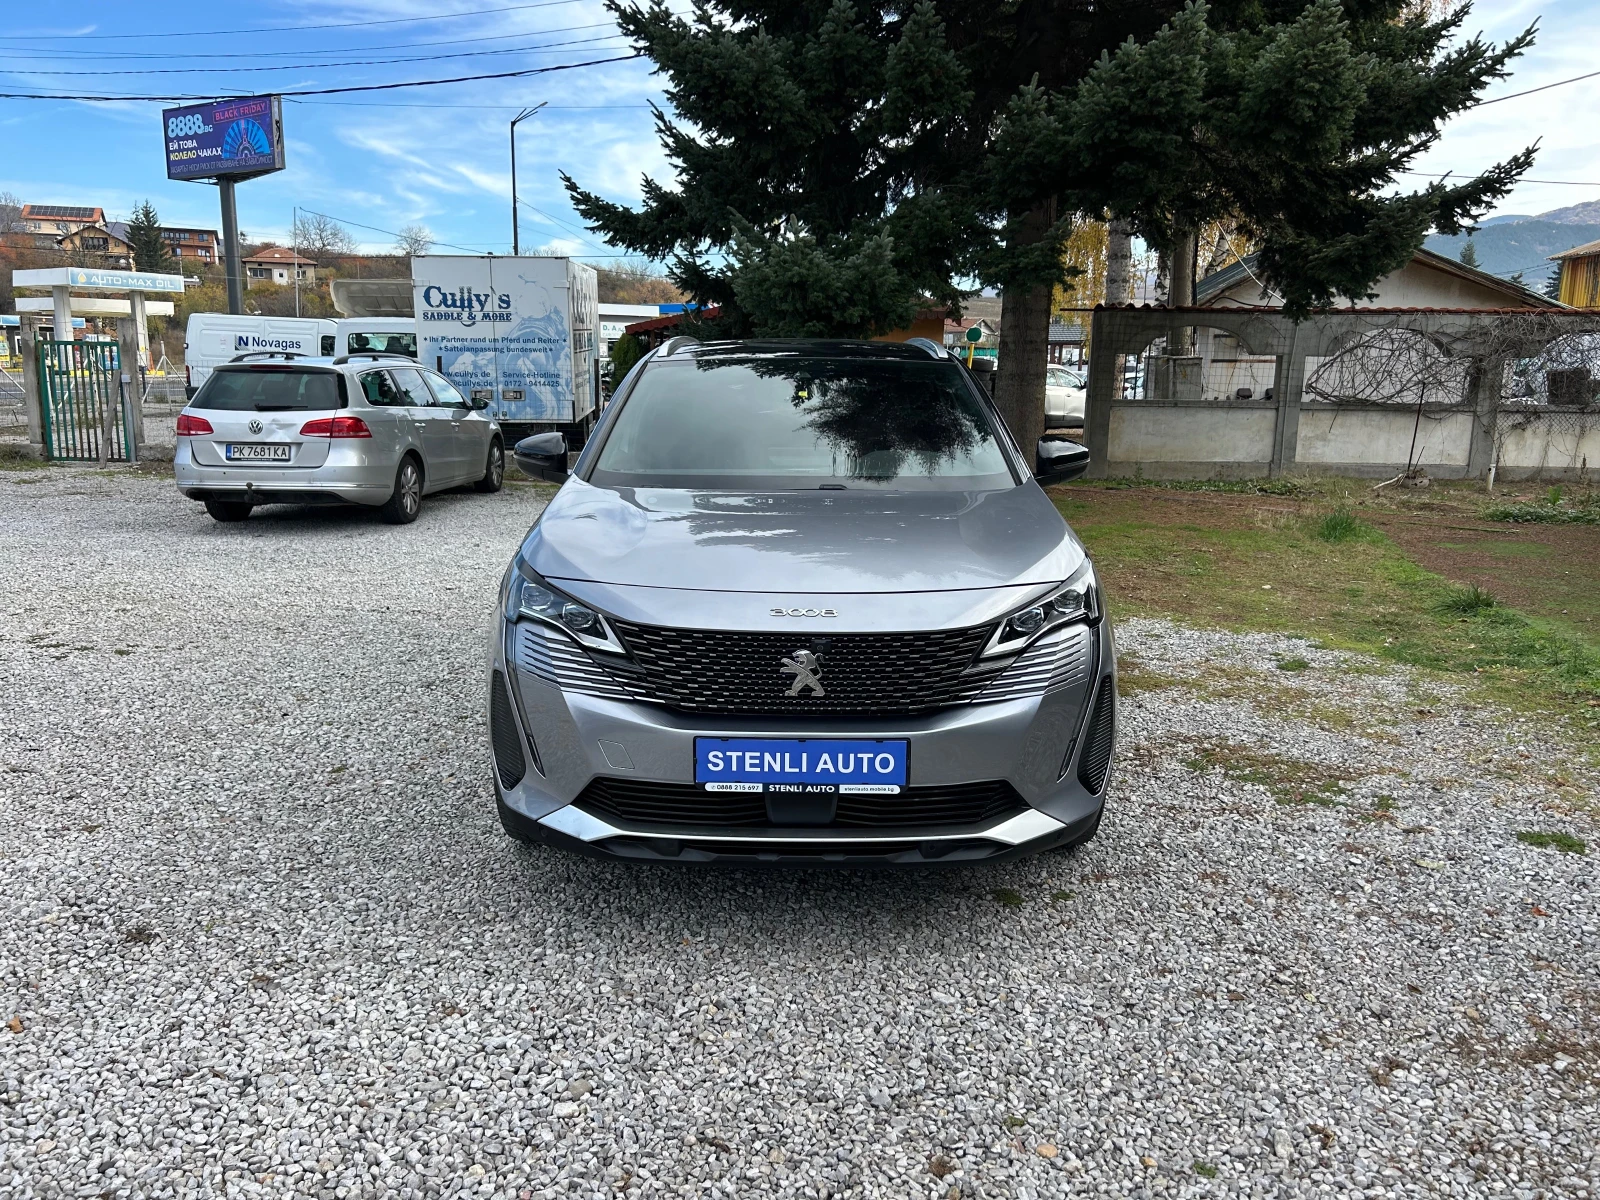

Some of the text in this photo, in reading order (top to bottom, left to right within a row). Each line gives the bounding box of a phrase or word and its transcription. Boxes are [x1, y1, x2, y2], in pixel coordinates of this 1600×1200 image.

[215, 102, 266, 121] BLACK FRIDAY
[169, 139, 198, 151] ЕЙ ТОВА
[170, 146, 222, 161] КОЛЕЛО ЧАКАХ
[156, 279, 175, 288] OIL
[422, 312, 512, 321] SADDLE & MORE
[252, 336, 302, 351] Novagas
[440, 336, 469, 344] Partner
[501, 336, 521, 344] Pferd
[522, 336, 538, 344] und
[444, 345, 505, 354] Sattelanpassung
[502, 371, 560, 379] Service-Hotline
[769, 608, 839, 617] 3008
[707, 750, 895, 774] STENLI AUTO
[768, 784, 803, 792] STENLI
[805, 784, 835, 793] AUTO
